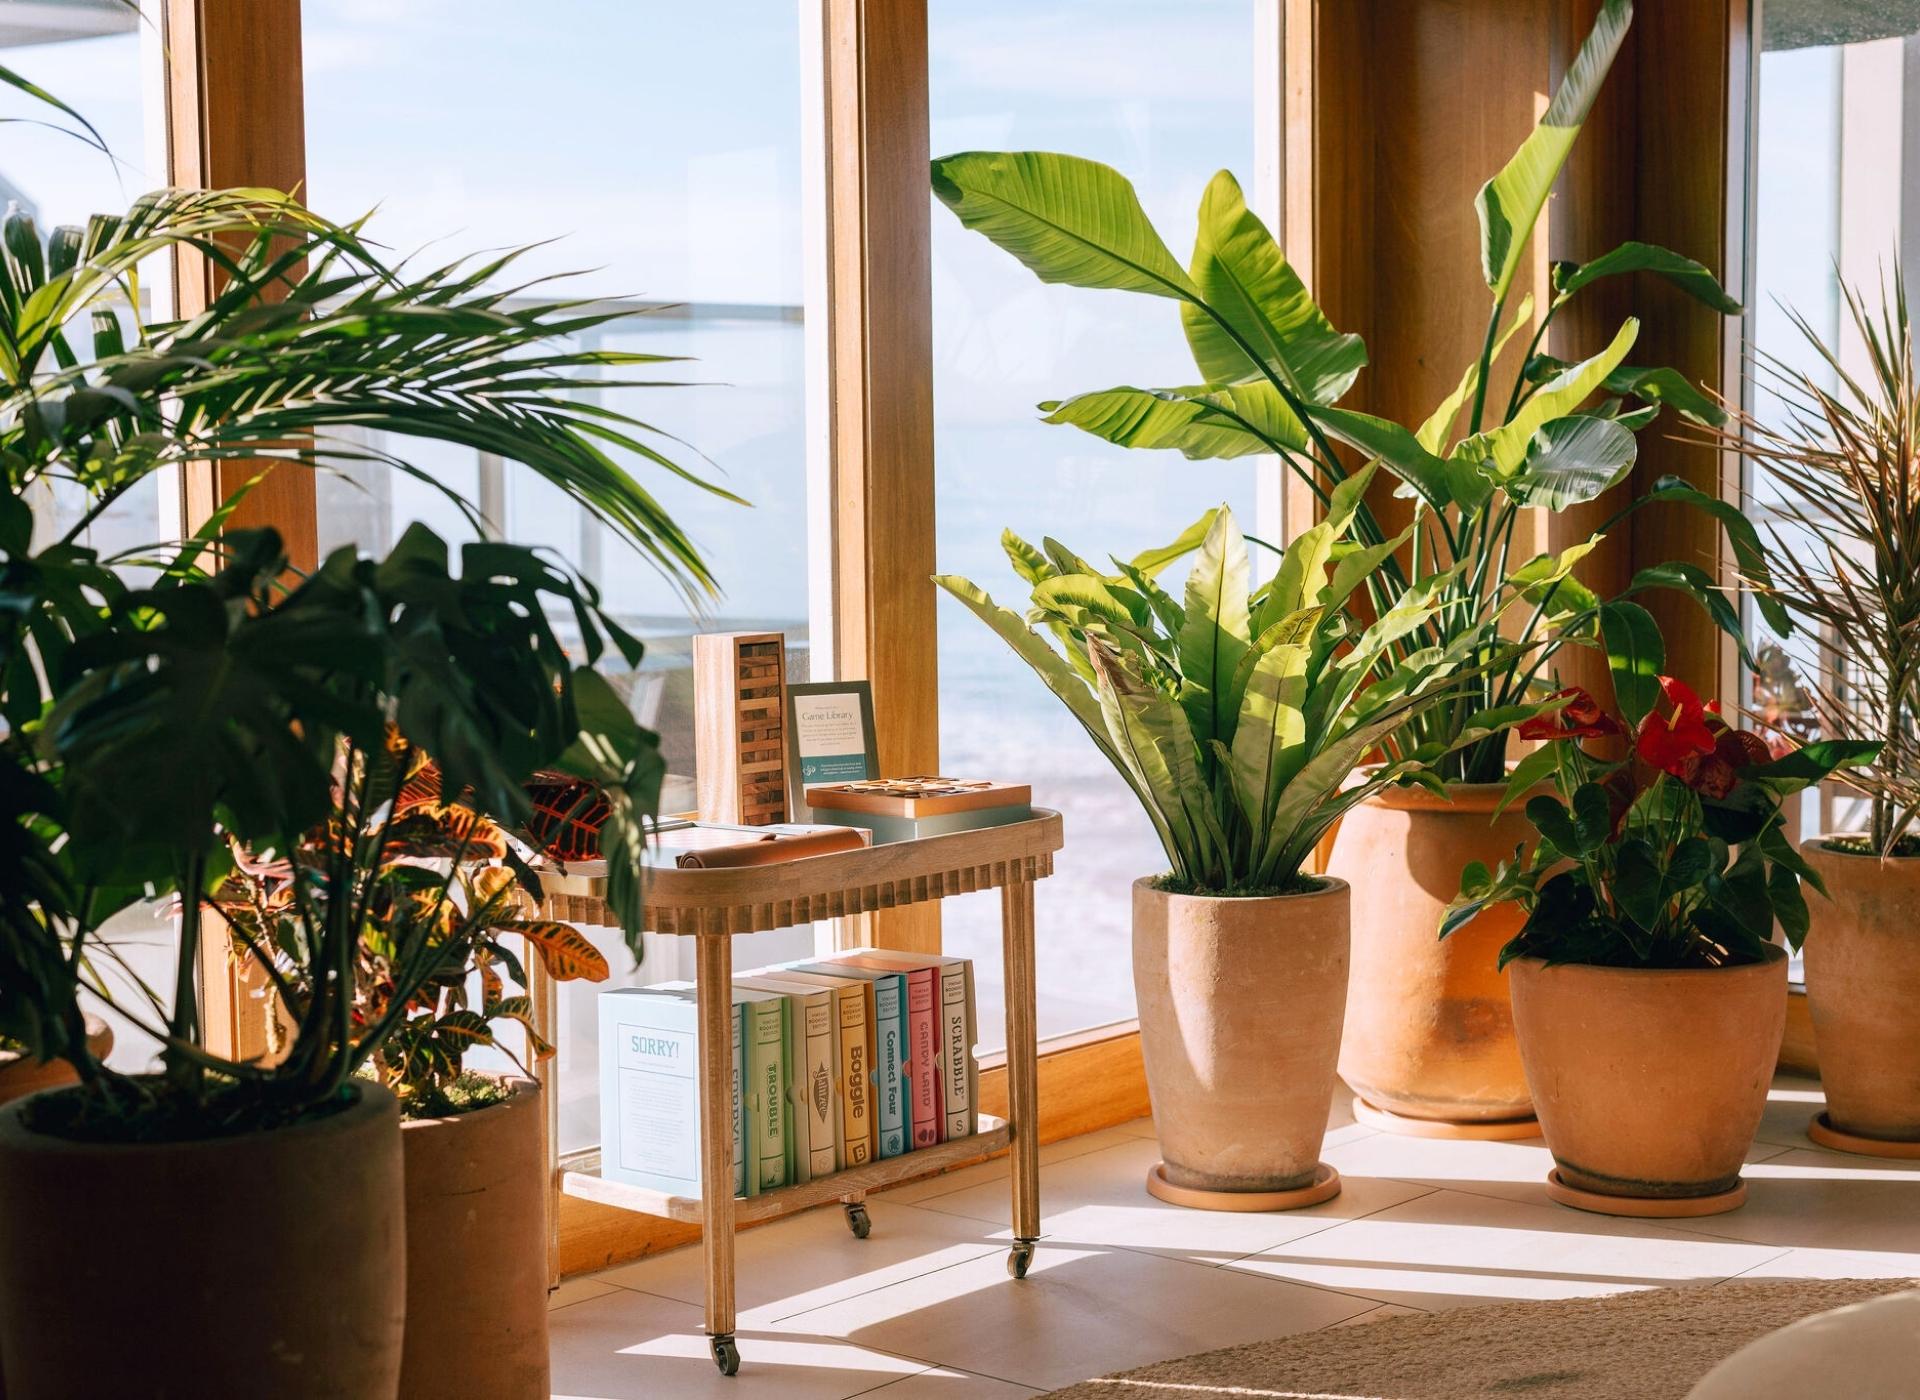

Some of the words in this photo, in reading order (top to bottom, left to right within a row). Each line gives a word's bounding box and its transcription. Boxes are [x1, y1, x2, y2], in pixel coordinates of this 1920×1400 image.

[802, 712, 825, 721] Game
[826, 711, 854, 721] Library
[631, 1036, 680, 1060] SORRY!
[886, 1030, 897, 1085] Connect
[951, 1016, 964, 1097] SCRABBLE
[767, 1063, 779, 1139] TROUBLE
[850, 1045, 864, 1119] Boggle
[887, 1087, 897, 1116] Four
[955, 1119, 964, 1132] S
